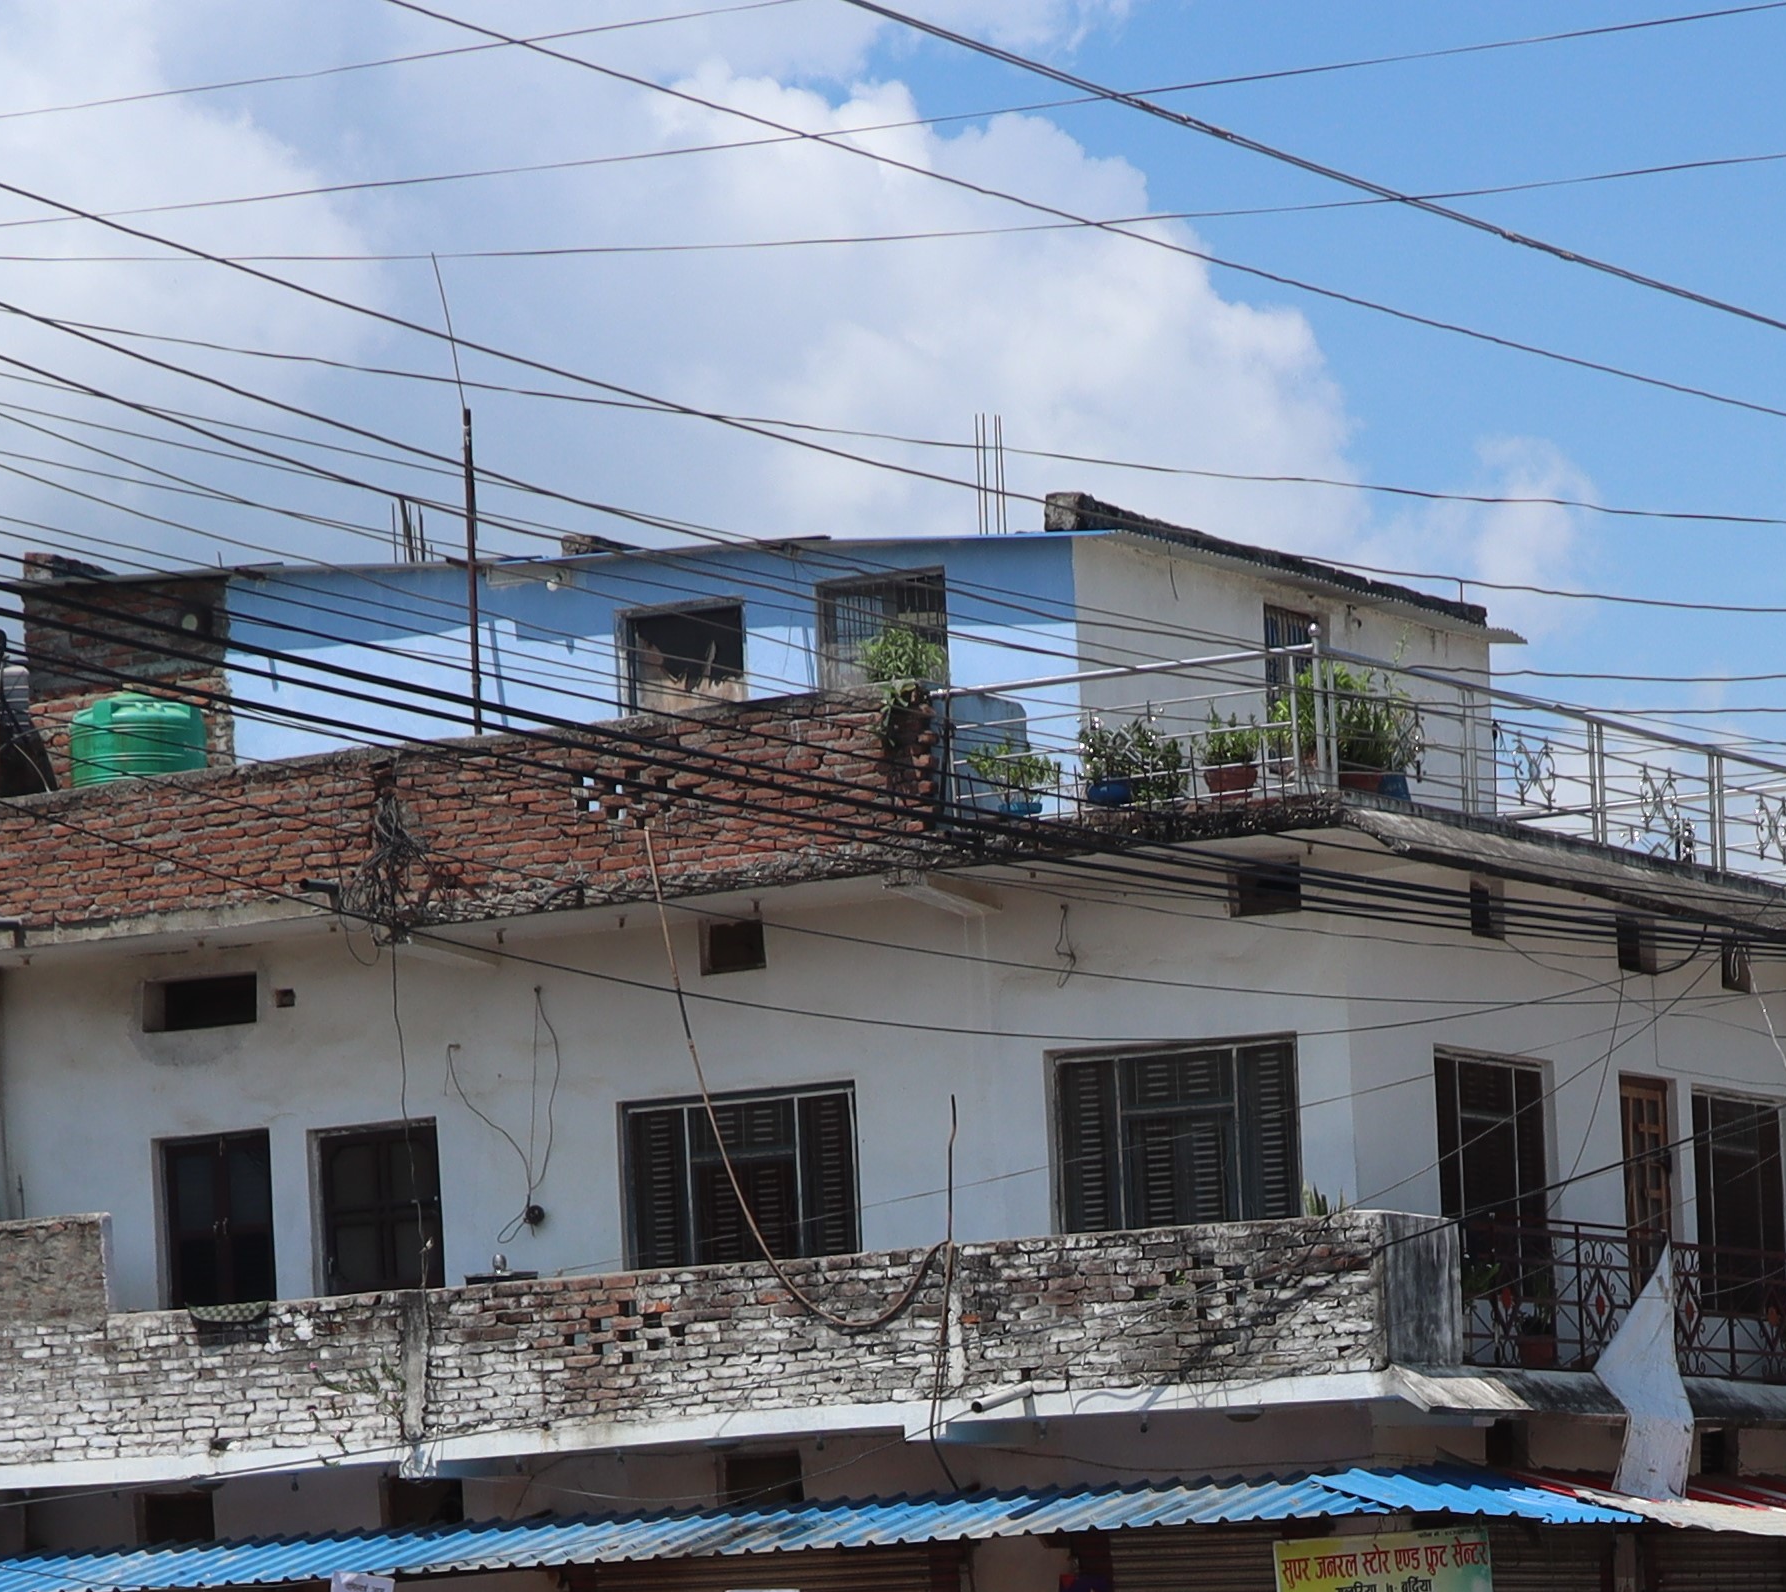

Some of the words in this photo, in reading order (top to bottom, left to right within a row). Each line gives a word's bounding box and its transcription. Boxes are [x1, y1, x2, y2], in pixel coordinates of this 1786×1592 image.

[1281, 1556, 1310, 1589] सुपर
[1314, 1553, 1358, 1580] जनरल
[1361, 1544, 1391, 1577] स्टोर
[1451, 1536, 1490, 1569] सेन्टर
